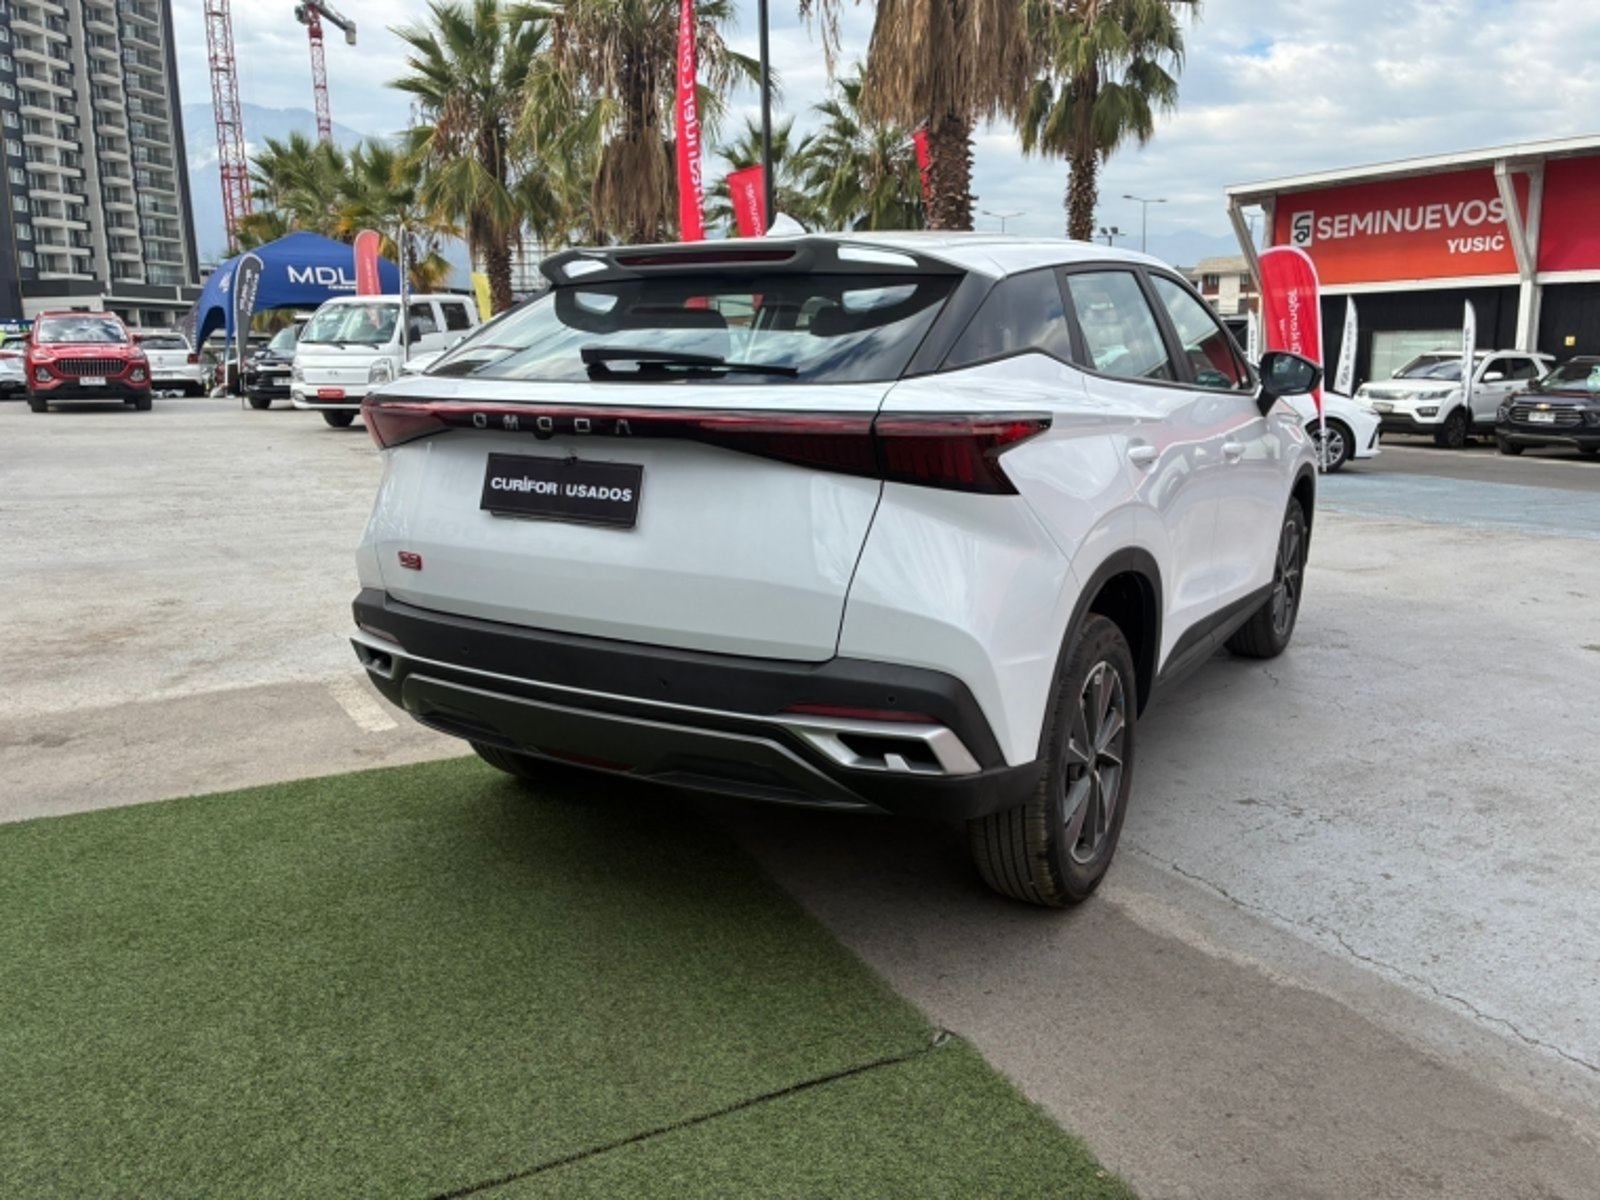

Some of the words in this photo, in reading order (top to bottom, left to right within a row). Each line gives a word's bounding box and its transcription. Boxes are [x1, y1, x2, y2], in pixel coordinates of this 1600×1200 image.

[1316, 199, 1506, 241] SEMINUEVOS
[287, 265, 357, 285] MDL
[565, 483, 633, 502] USADOS
